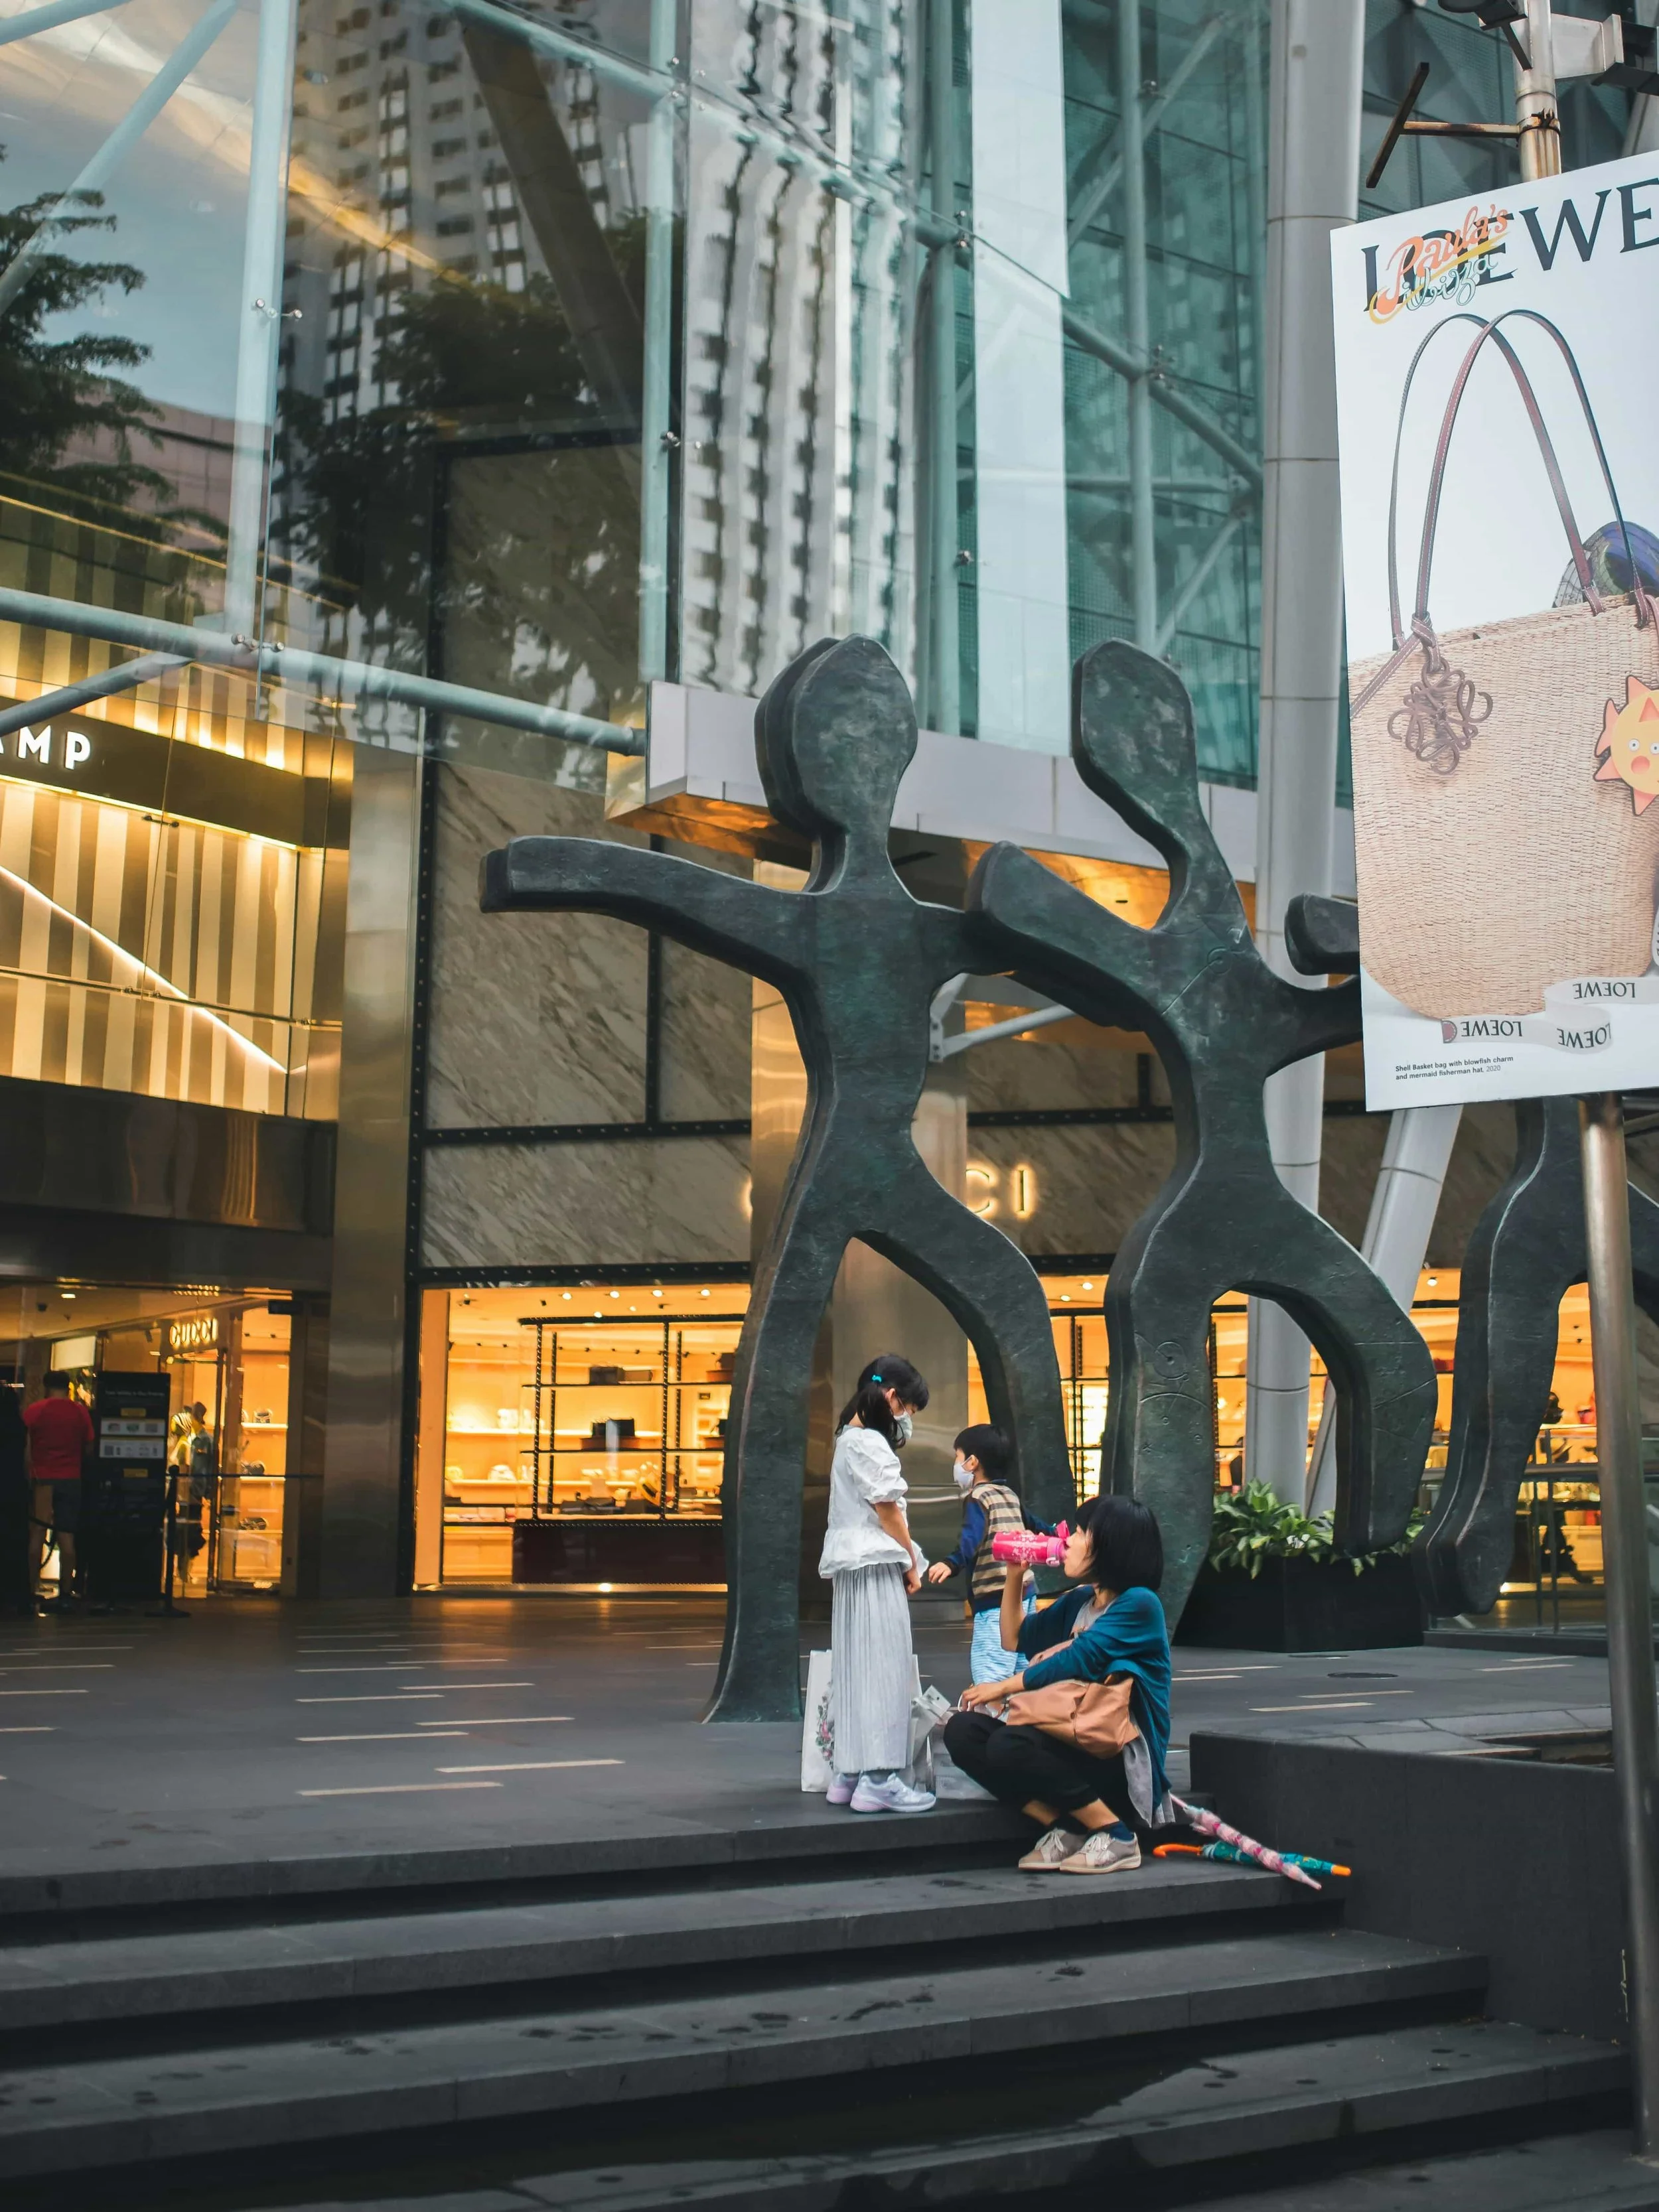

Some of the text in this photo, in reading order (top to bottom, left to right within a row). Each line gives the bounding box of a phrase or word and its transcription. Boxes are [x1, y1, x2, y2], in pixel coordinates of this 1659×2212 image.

[1361, 178, 1659, 312] LOEWE
[1376, 204, 1508, 314] Paula's
[0, 725, 90, 770] MP
[1573, 982, 1636, 1000] LOEWE
[1461, 1020, 1522, 1037] LOEWE
[169, 1318, 218, 1348] GUCCI
